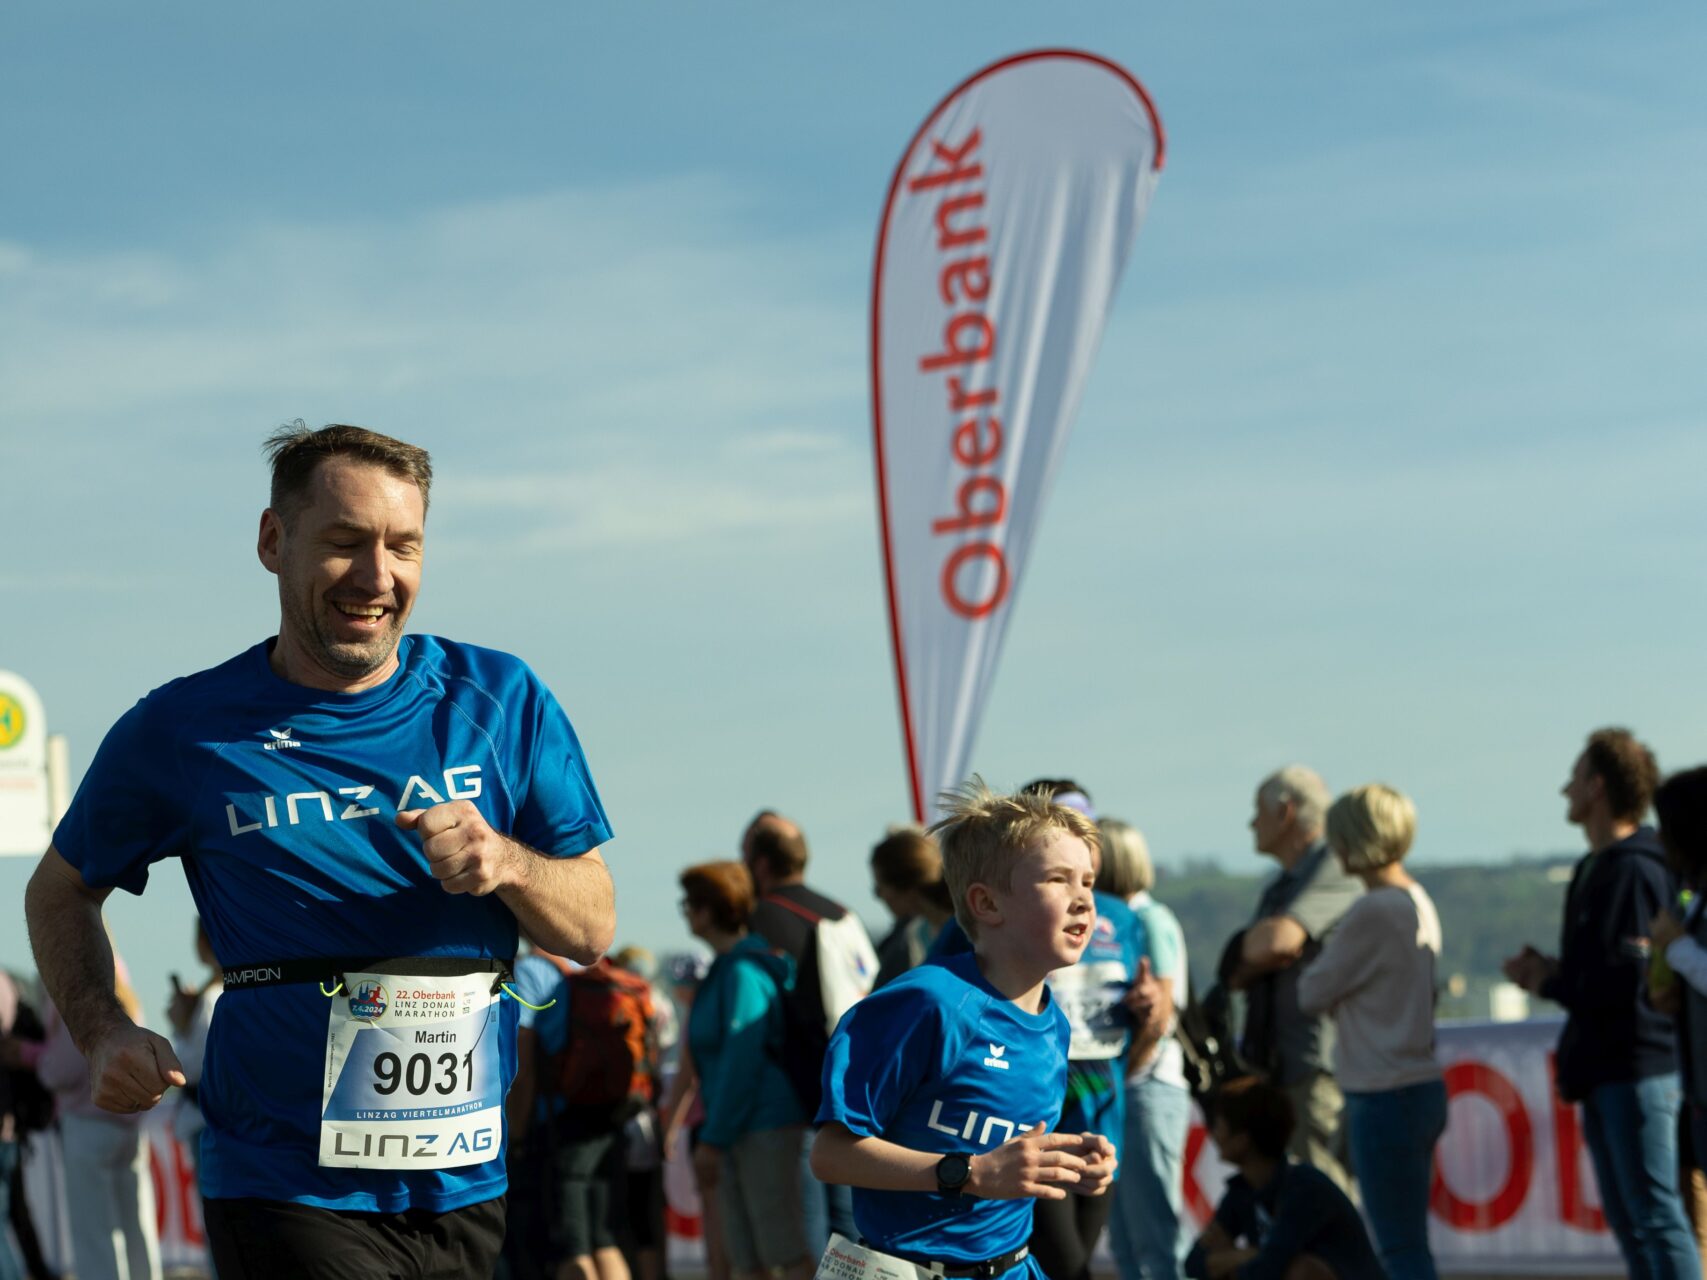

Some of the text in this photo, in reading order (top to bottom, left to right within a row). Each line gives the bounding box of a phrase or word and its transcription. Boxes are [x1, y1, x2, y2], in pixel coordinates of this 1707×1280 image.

[908, 125, 1013, 621] Oberbank
[263, 738, 301, 751] erima
[225, 764, 482, 837] LINZ AG
[395, 989, 456, 1000] 22. Oberbank
[394, 1000, 456, 1009] LINZ DONAU
[394, 1009, 456, 1018] MARATHON
[414, 1030, 457, 1044] Martin
[373, 1050, 473, 1096] 9031
[402, 1102, 483, 1118] VIERTELMARATHON
[927, 1099, 1036, 1145] LIN
[334, 1127, 493, 1158] LINZ AG
[833, 1259, 866, 1276] DONAU
